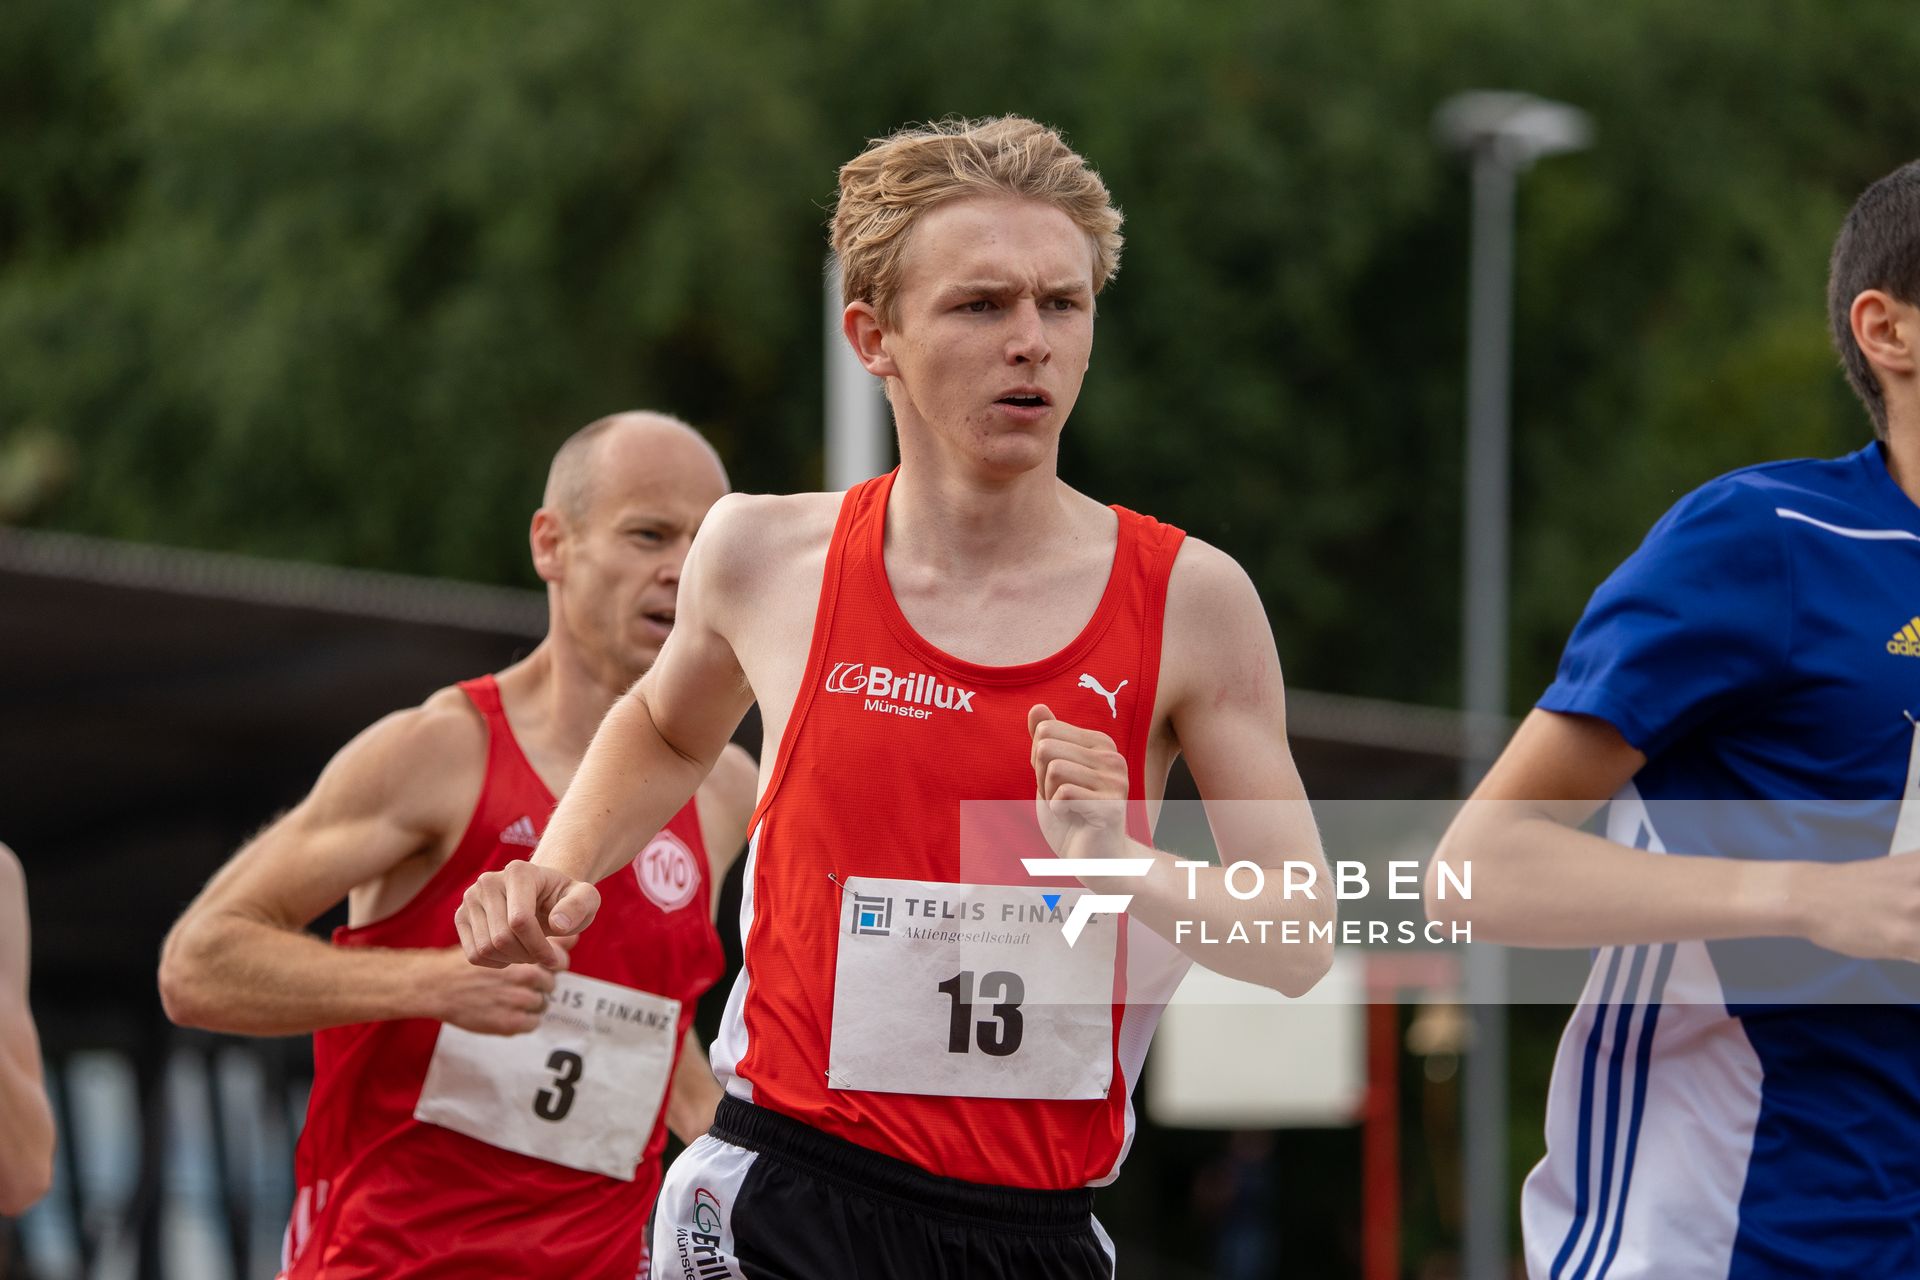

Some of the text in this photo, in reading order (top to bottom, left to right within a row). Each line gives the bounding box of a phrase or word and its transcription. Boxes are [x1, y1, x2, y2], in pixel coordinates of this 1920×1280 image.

[866, 666, 976, 712] Brillux
[864, 698, 932, 720] Münster
[648, 848, 687, 891] TVO
[905, 898, 1098, 924] TELIS FINAZ
[903, 926, 1031, 945] Aktiengesellschaft
[595, 998, 670, 1032] FINANZ
[938, 970, 1026, 1057] 13
[532, 1050, 584, 1123] 3
